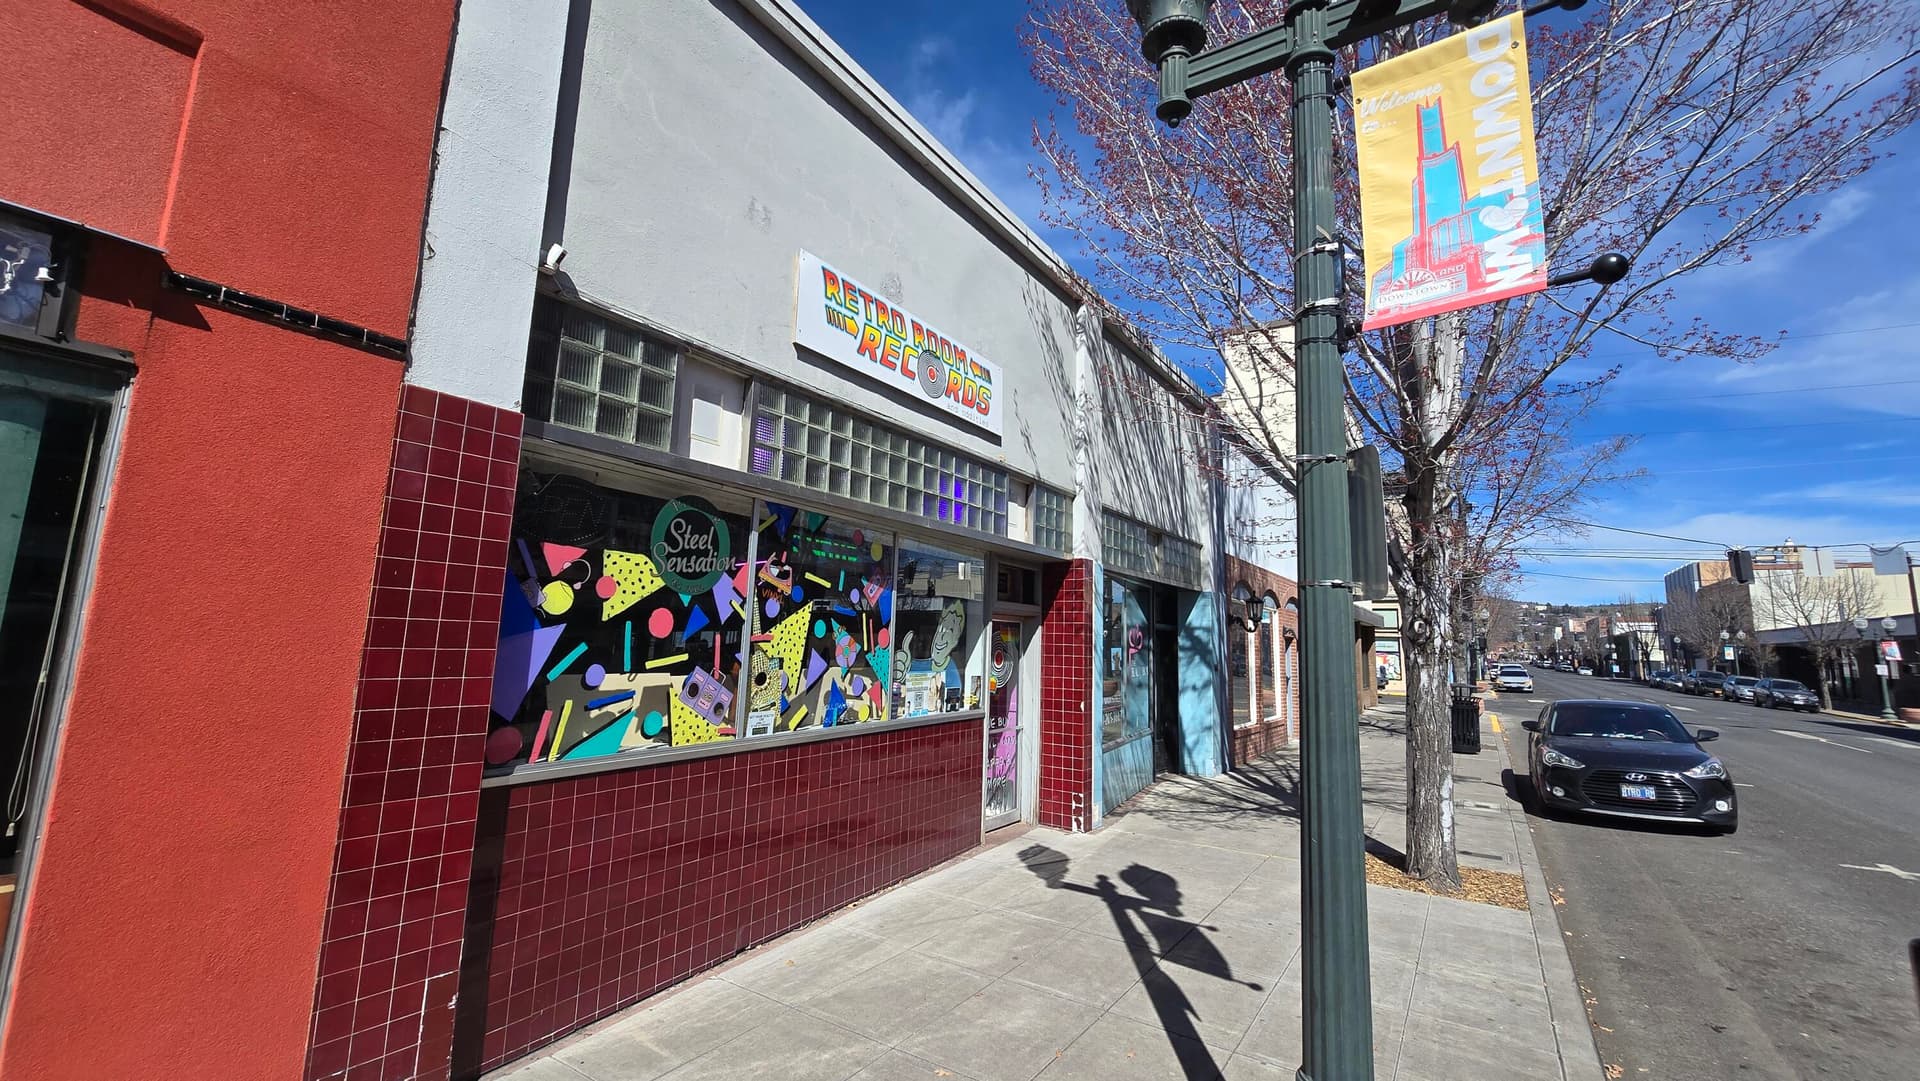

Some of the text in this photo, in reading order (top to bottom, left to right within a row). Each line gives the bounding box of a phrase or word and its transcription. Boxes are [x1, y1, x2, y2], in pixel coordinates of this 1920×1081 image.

[1360, 83, 1442, 118] Welcome
[821, 265, 969, 376] RETRO ROOM
[857, 322, 992, 416] RECORDS
[670, 518, 715, 553] Steel
[651, 541, 738, 577] Sensation
